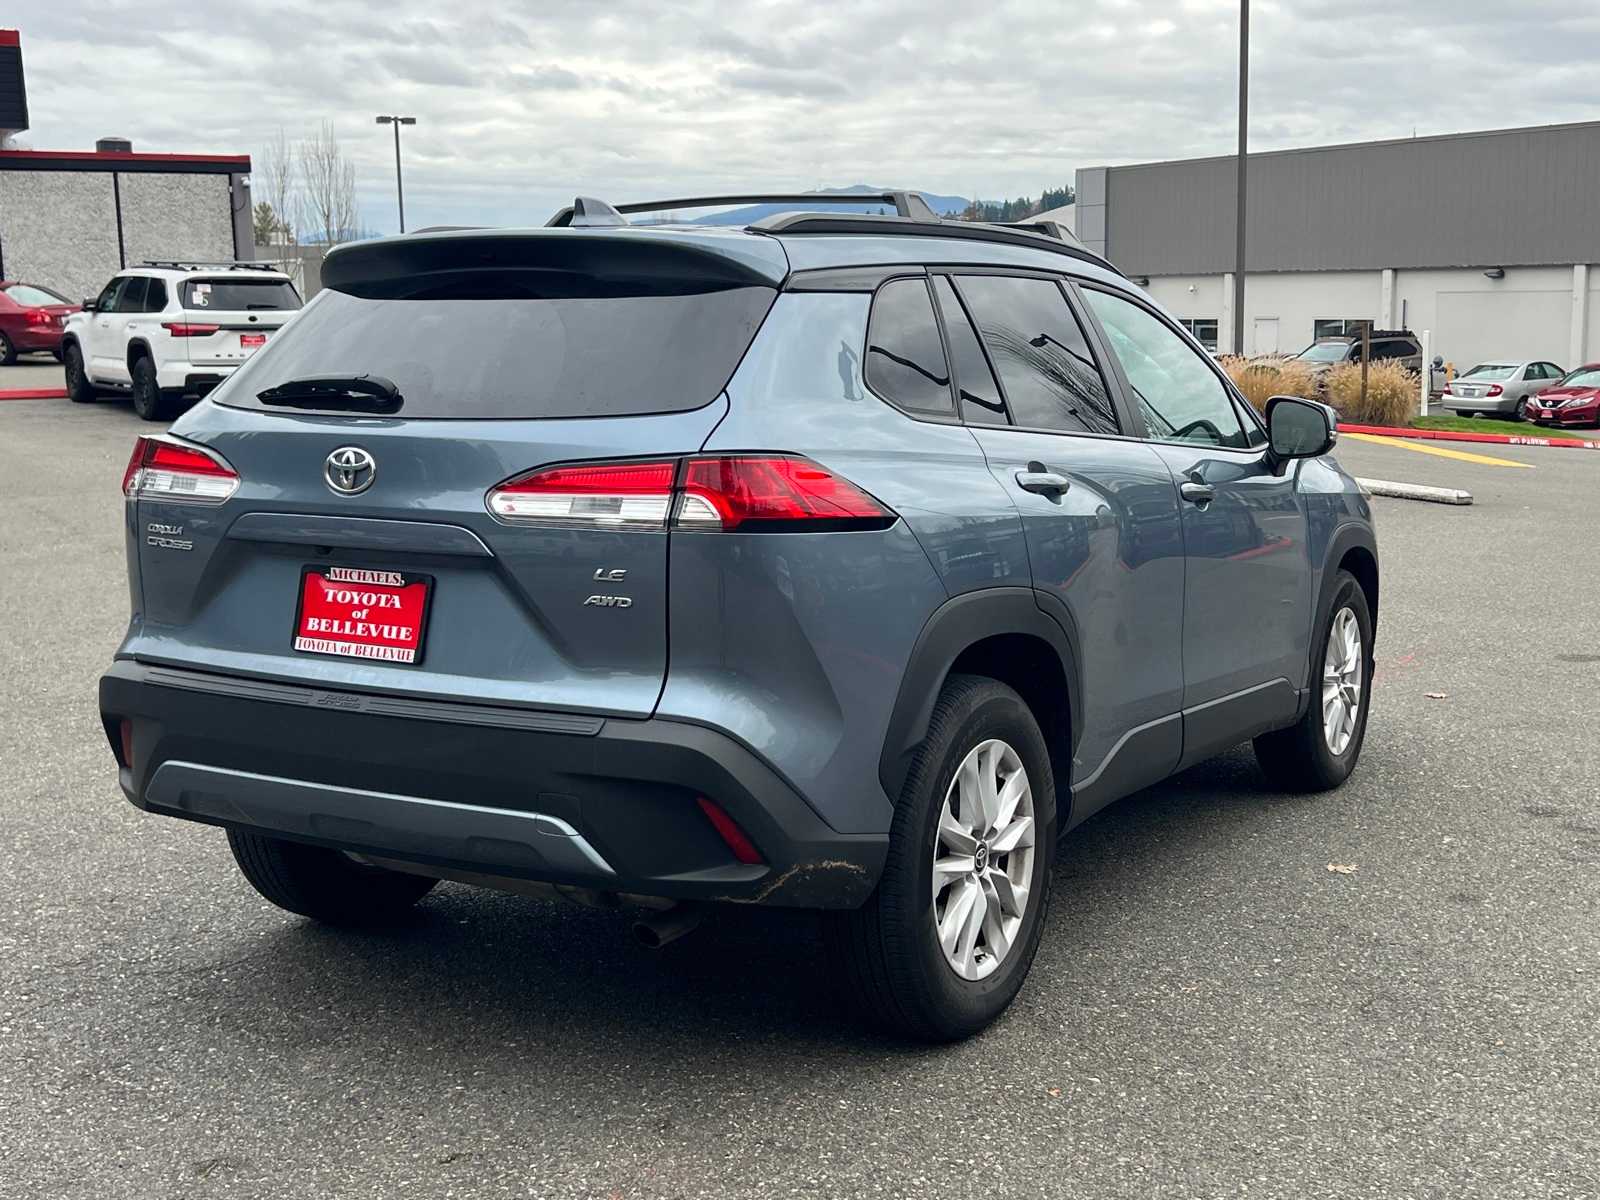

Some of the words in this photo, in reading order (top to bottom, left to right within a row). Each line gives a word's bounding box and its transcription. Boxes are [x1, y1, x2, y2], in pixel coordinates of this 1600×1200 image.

[147, 536, 193, 550] CROSS
[331, 569, 400, 584] MICHAELS
[593, 568, 627, 581] LE
[324, 588, 402, 609] TOYOTA
[584, 595, 632, 607] AWD
[352, 609, 369, 620] of
[306, 617, 413, 641] BELLEVUE
[297, 638, 337, 653] TOYOTA
[340, 645, 352, 655] of
[354, 645, 414, 661] BELLEVUE
